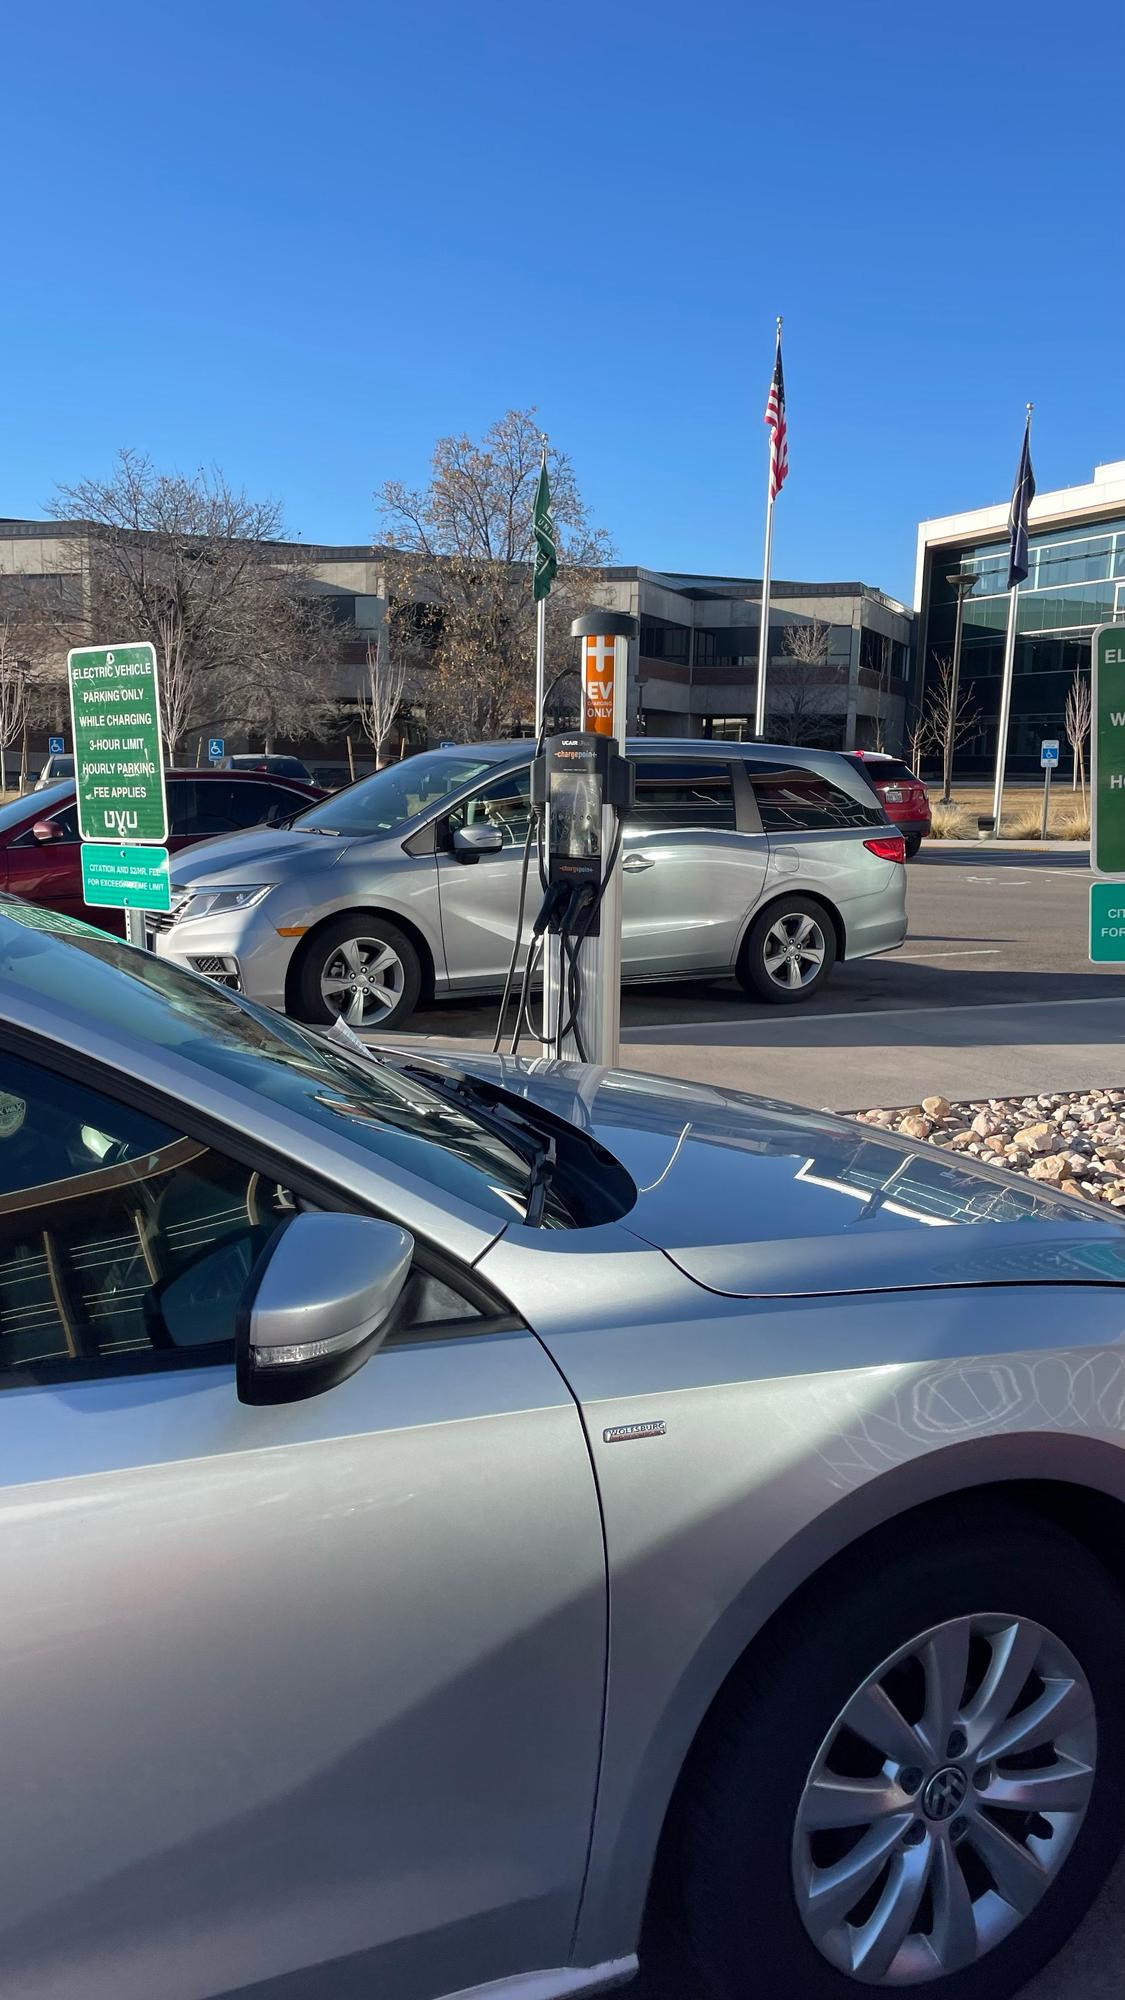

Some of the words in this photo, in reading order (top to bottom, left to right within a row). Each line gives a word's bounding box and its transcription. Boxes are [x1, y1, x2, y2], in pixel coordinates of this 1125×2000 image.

[74, 665, 113, 680] ELECTRIC
[115, 662, 152, 676] VEHICLE
[84, 690, 119, 703] PARKING
[121, 688, 144, 700] ONLY
[588, 682, 612, 699] EV
[587, 708, 612, 718] ONLY
[79, 715, 105, 727] WHILE
[107, 713, 152, 726] CHARGING
[89, 739, 120, 751] 3-HOUR
[122, 738, 145, 750] LIMIT
[82, 763, 116, 775] HOURLY
[118, 762, 155, 775] PARKING
[93, 787, 110, 798] FEE
[112, 786, 147, 798] APPLIES
[104, 811, 138, 829] UVU
[89, 864, 115, 873] CITATION
[117, 866, 129, 874] AND
[87, 878, 99, 886] FOR
[149, 882, 164, 891] LIMIT
[608, 1422, 665, 1436] WOLFSBURG
